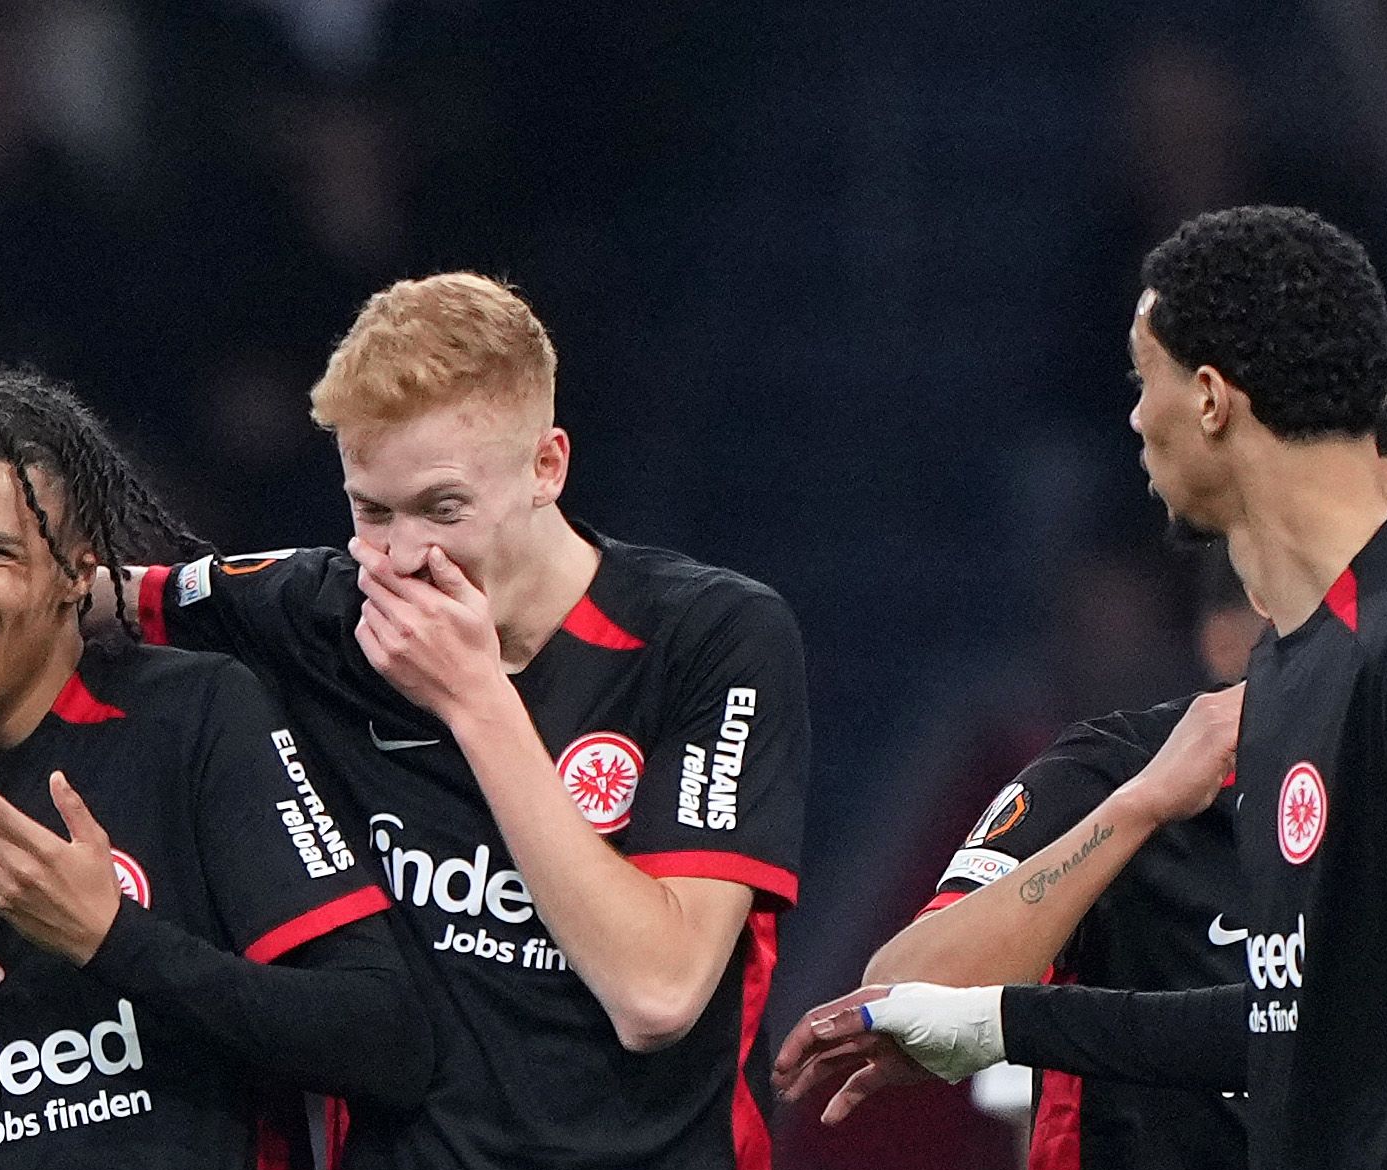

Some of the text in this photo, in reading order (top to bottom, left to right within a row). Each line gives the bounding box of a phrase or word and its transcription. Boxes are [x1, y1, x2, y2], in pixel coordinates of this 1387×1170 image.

[677, 742, 709, 829] reload
[706, 687, 757, 831] ELOTRANS
[270, 728, 356, 872] ELOTRANS
[275, 799, 337, 879] reload
[370, 813, 534, 924] inde
[434, 924, 567, 971] Jobs fin
[1246, 913, 1306, 990] eed
[1268, 1000, 1299, 1032] find
[44, 1089, 153, 1132] finden
